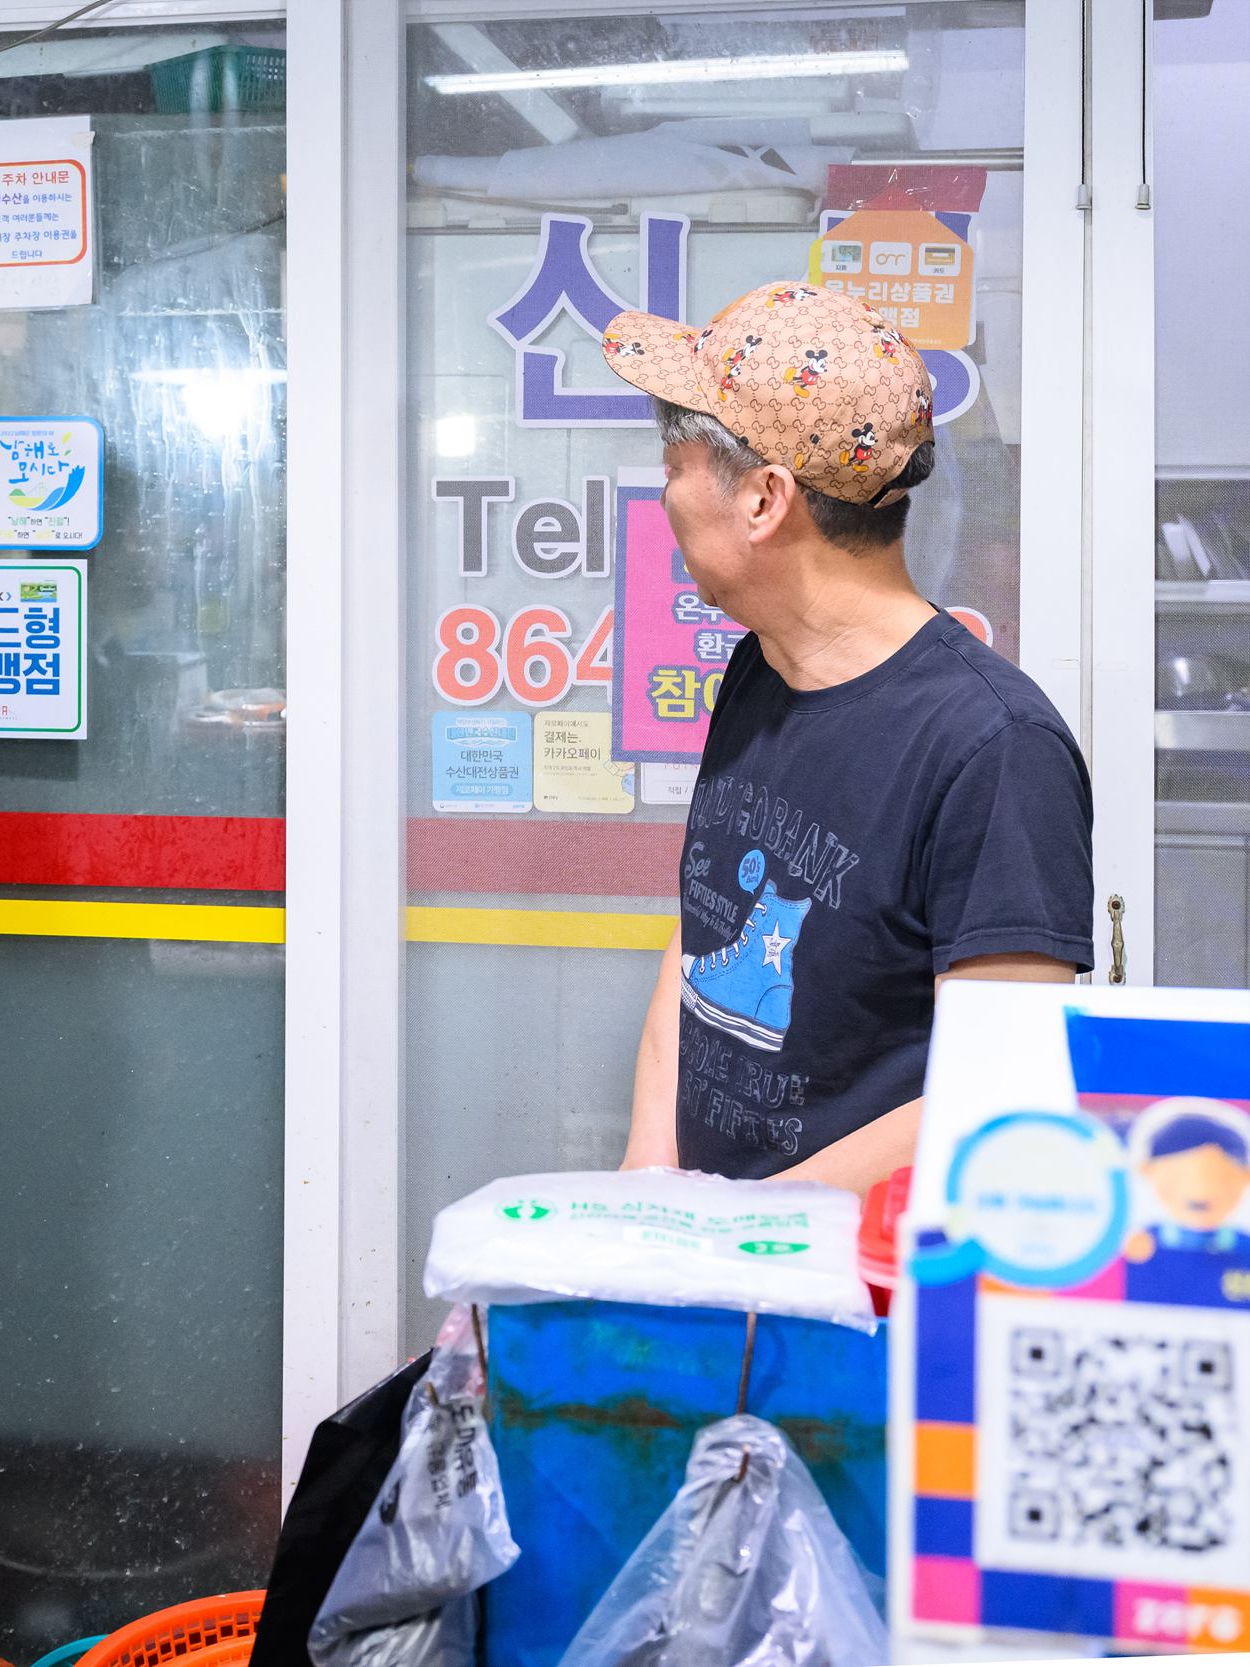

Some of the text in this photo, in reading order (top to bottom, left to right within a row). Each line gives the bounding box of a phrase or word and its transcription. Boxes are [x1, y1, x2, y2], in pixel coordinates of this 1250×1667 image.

[2, 172, 26, 186] 주차
[32, 170, 69, 185] 안내문
[33, 193, 72, 204] 이용하시는
[12, 213, 59, 223] 여러분들께는
[14, 231, 40, 242] 주차장
[43, 229, 77, 240] 이용권을
[11, 250, 43, 260] 드립니다
[0, 439, 59, 461] 남해로
[435, 480, 605, 573] Tel
[544, 731, 582, 744] 결제는.
[460, 750, 504, 763] 대한민국
[544, 747, 601, 760] 카카오페이
[446, 766, 519, 779] 수산대전상품권
[685, 841, 711, 879] See
[688, 879, 717, 910] FIFTIES
[716, 895, 739, 924] STYLE
